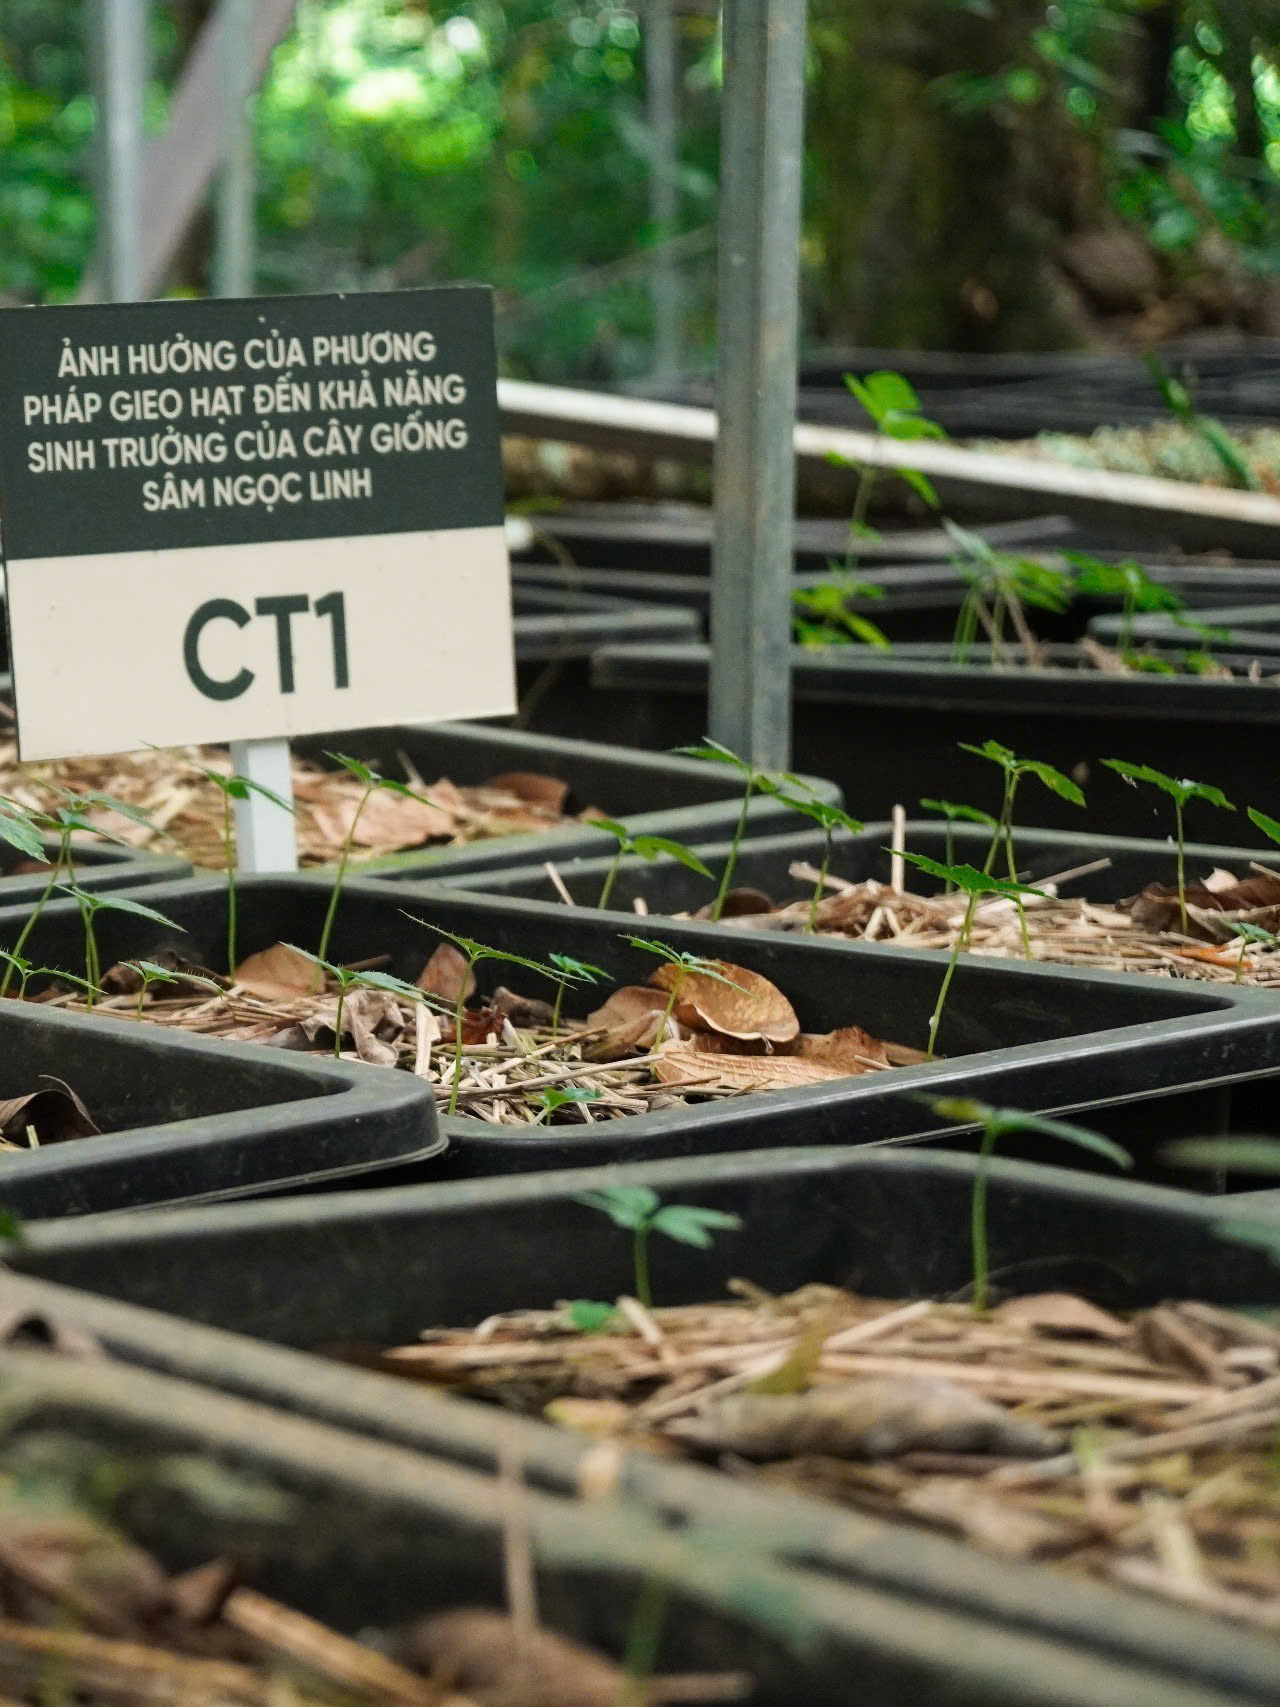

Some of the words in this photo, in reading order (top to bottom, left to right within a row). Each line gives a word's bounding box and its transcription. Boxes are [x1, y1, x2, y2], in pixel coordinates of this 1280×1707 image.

[58, 337, 120, 378] ẢNH
[128, 332, 238, 374] HƯỞNG
[244, 328, 307, 370] CỦA
[313, 331, 437, 366] PHƯƠNG
[24, 385, 102, 425] PHÁP
[109, 388, 183, 421] GIEO
[190, 385, 245, 425] HẠT
[253, 371, 312, 414] ĐẾN
[318, 368, 378, 411] KHẢ
[383, 368, 467, 408] NĂNG
[27, 439, 96, 473] SINH
[102, 425, 228, 469] TRƯỞNG
[234, 419, 297, 461] CỦA
[303, 417, 363, 457] CÂY
[370, 409, 469, 453] GIỐNG
[142, 472, 206, 512] SÂM
[212, 472, 303, 513] NGỌC
[309, 467, 372, 500] LINH
[183, 591, 349, 702] CT1
